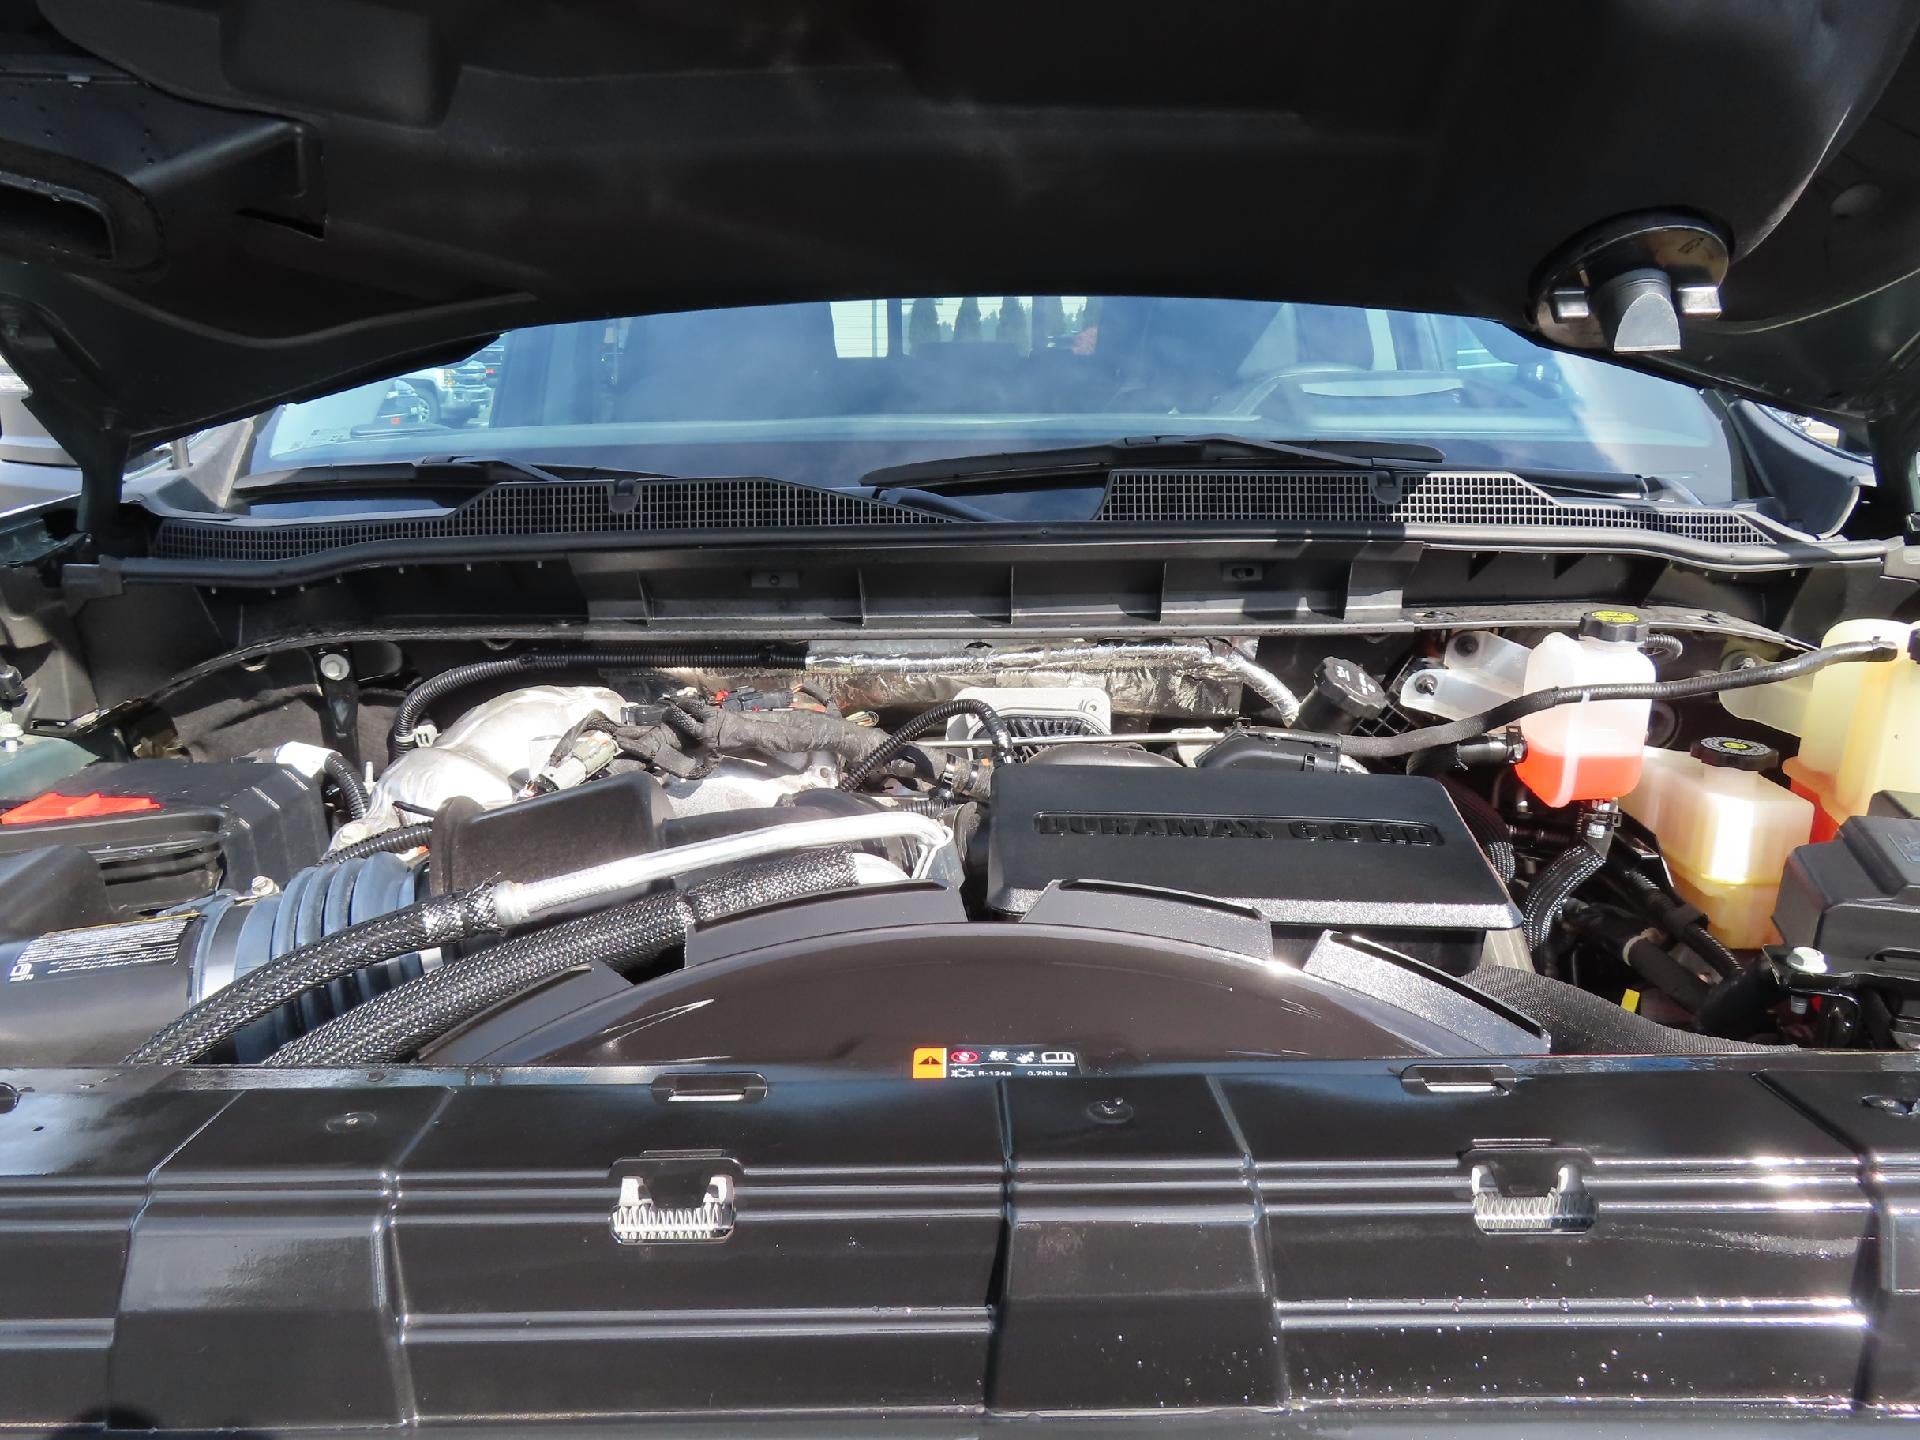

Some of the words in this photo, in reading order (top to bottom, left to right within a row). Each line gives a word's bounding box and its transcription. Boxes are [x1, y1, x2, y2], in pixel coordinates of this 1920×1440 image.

[1038, 815, 1274, 839] DURAMAX
[1288, 820, 1361, 843] 6.6
[1371, 823, 1434, 847] HD
